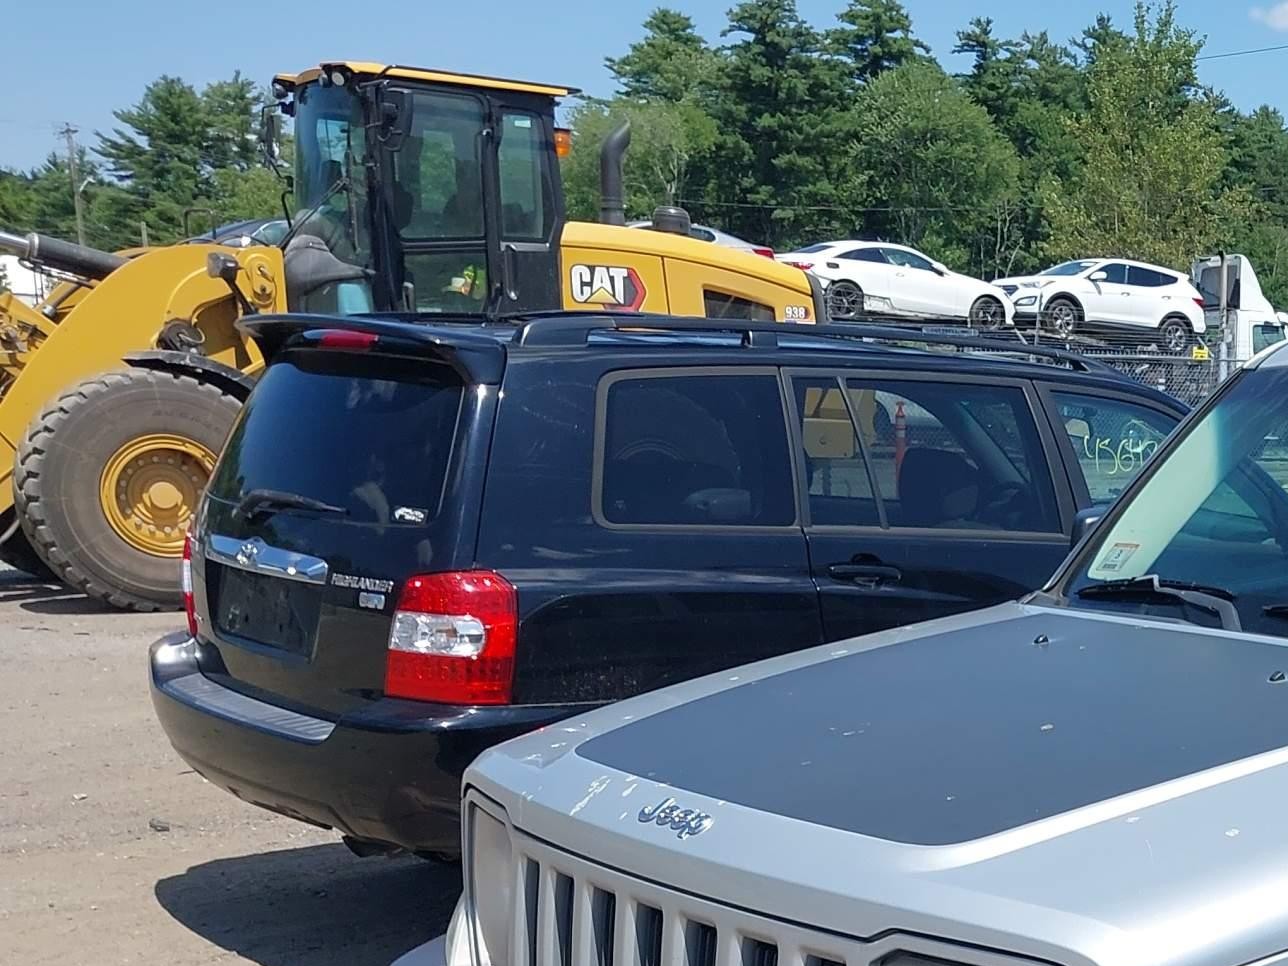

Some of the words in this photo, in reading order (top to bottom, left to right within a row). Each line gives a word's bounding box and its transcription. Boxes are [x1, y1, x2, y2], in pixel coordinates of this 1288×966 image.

[572, 265, 629, 304] CAT
[785, 306, 806, 319] 938
[331, 572, 395, 594] HIGHLANDER
[638, 797, 714, 840] Jeep
